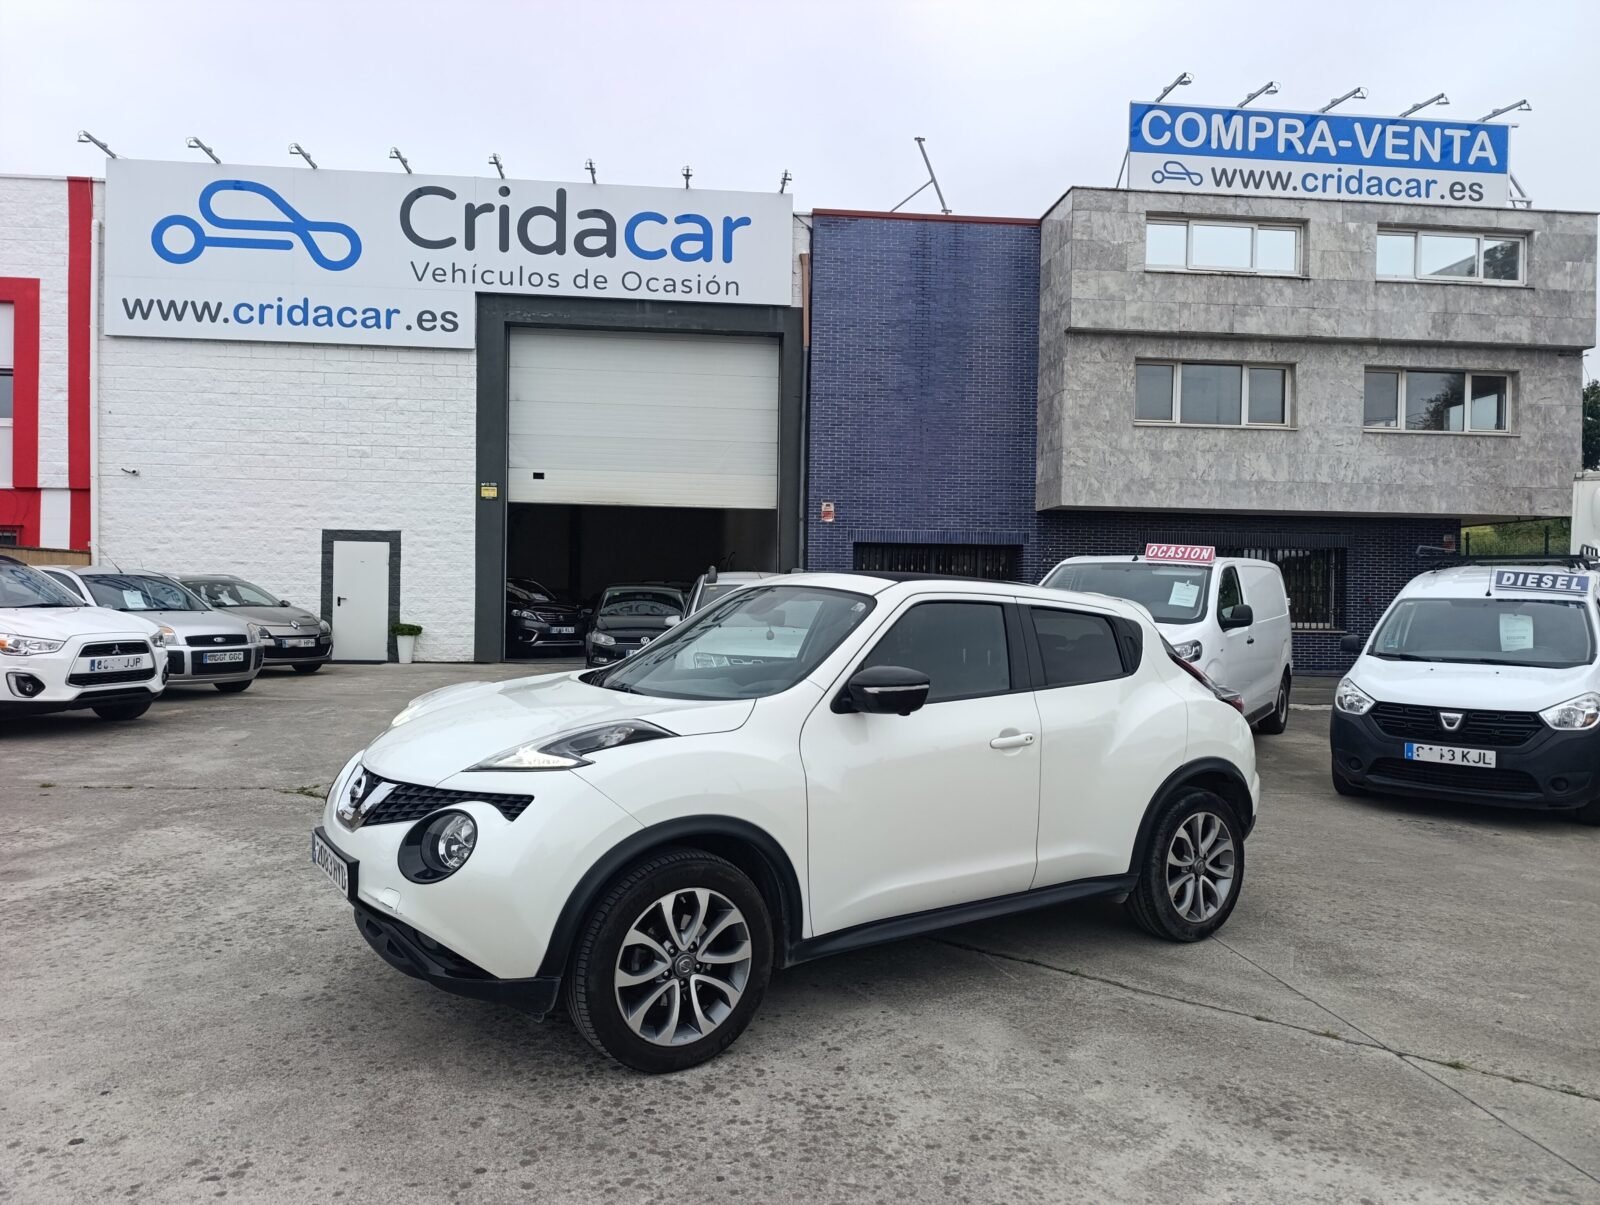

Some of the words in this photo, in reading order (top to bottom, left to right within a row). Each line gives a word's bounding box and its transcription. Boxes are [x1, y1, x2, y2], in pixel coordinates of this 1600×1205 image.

[1141, 110, 1497, 166] COMPRA-VENTA
[1211, 167, 1484, 201] www.cridacar.es
[400, 186, 752, 263] Cridacar
[410, 261, 560, 289] Vehículos
[573, 269, 608, 290] de
[621, 271, 740, 296] Ocasión
[1148, 546, 1211, 559] OCASION
[1501, 572, 1581, 590] DIESEL
[124, 657, 141, 668] JJP
[1461, 750, 1492, 765] KJL
